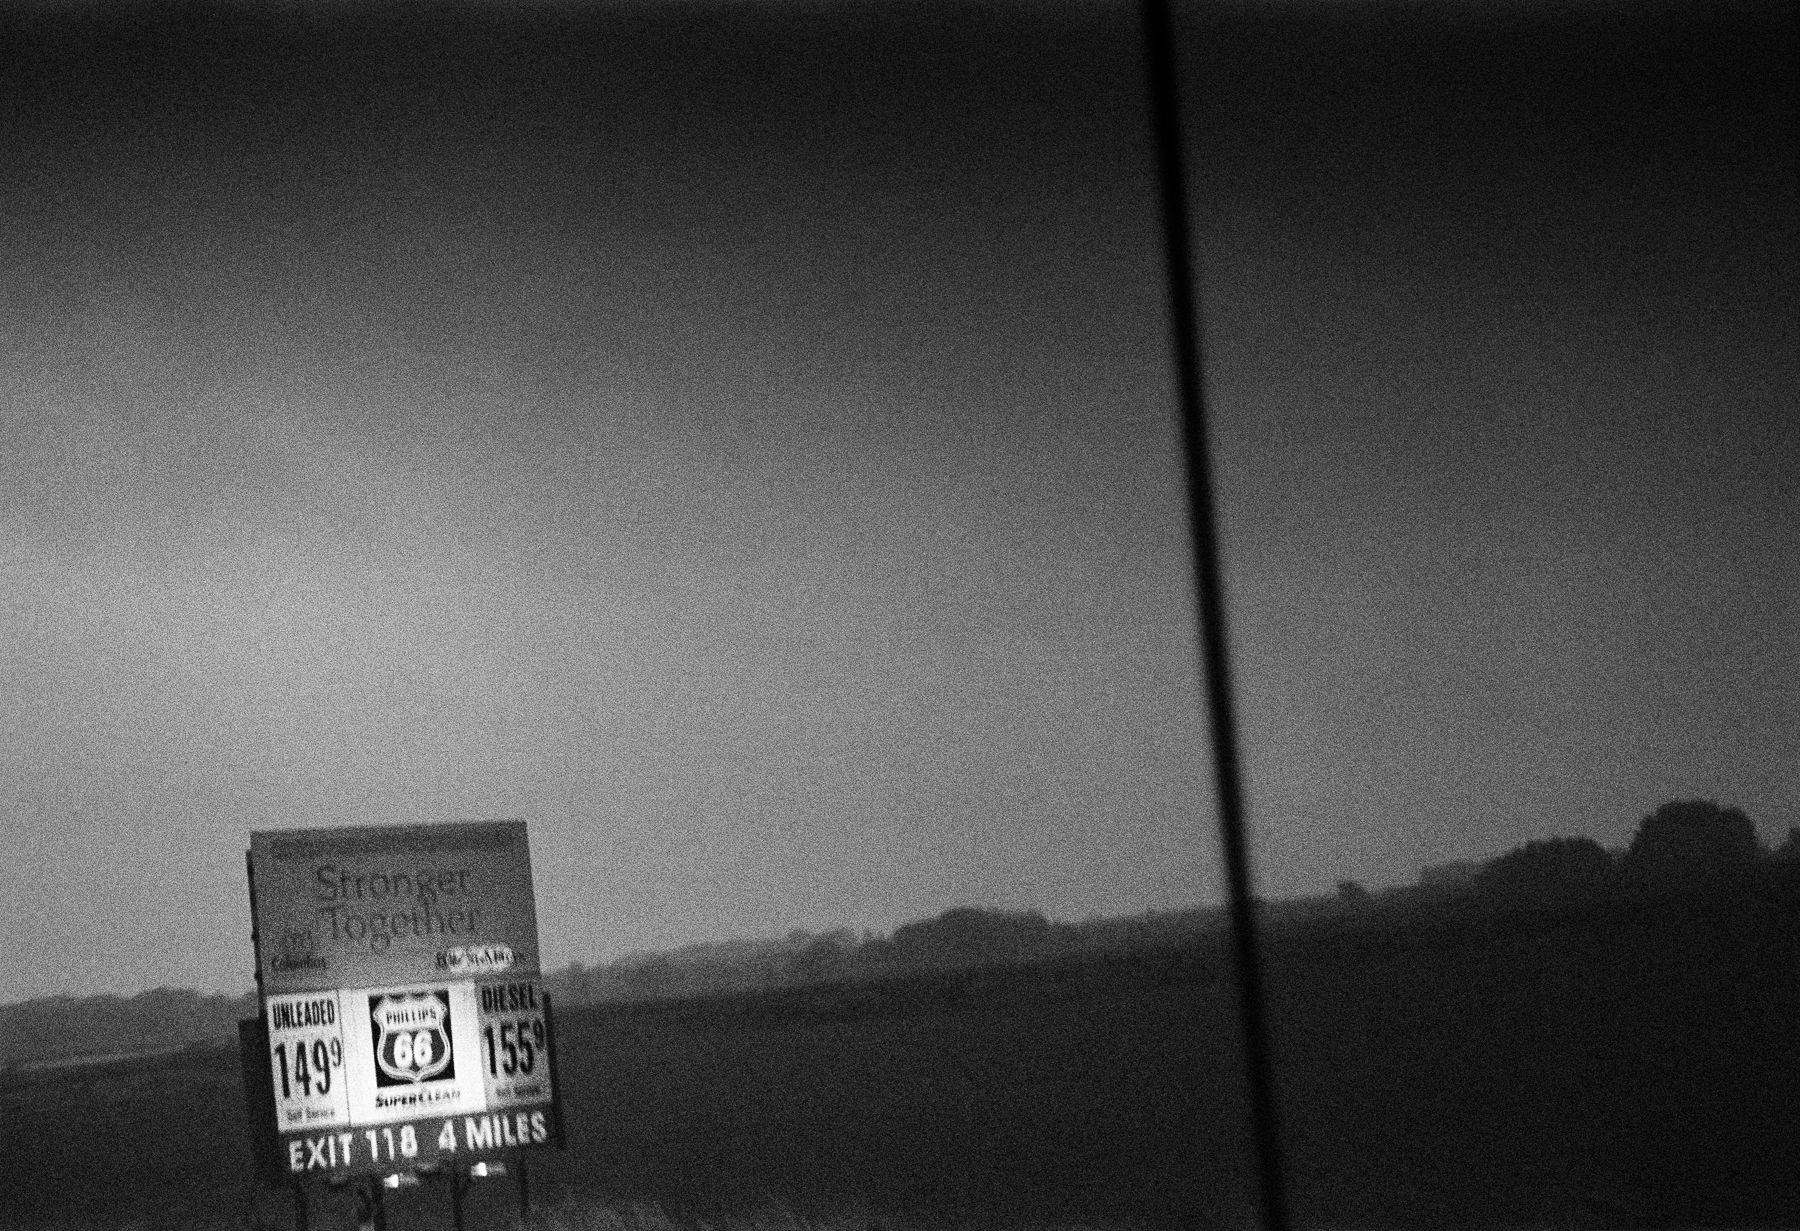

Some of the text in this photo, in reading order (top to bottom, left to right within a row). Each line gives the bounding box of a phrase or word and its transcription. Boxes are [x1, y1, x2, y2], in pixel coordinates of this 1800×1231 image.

[316, 864, 470, 904] Stronger
[319, 901, 480, 955] Together
[272, 1000, 336, 1030] UNLEADED
[386, 1008, 437, 1025] PHILLIPS
[481, 983, 536, 1014] DIESEL
[393, 1029, 433, 1069] 66
[288, 1110, 548, 1172] EXIT 118 4 MILES
